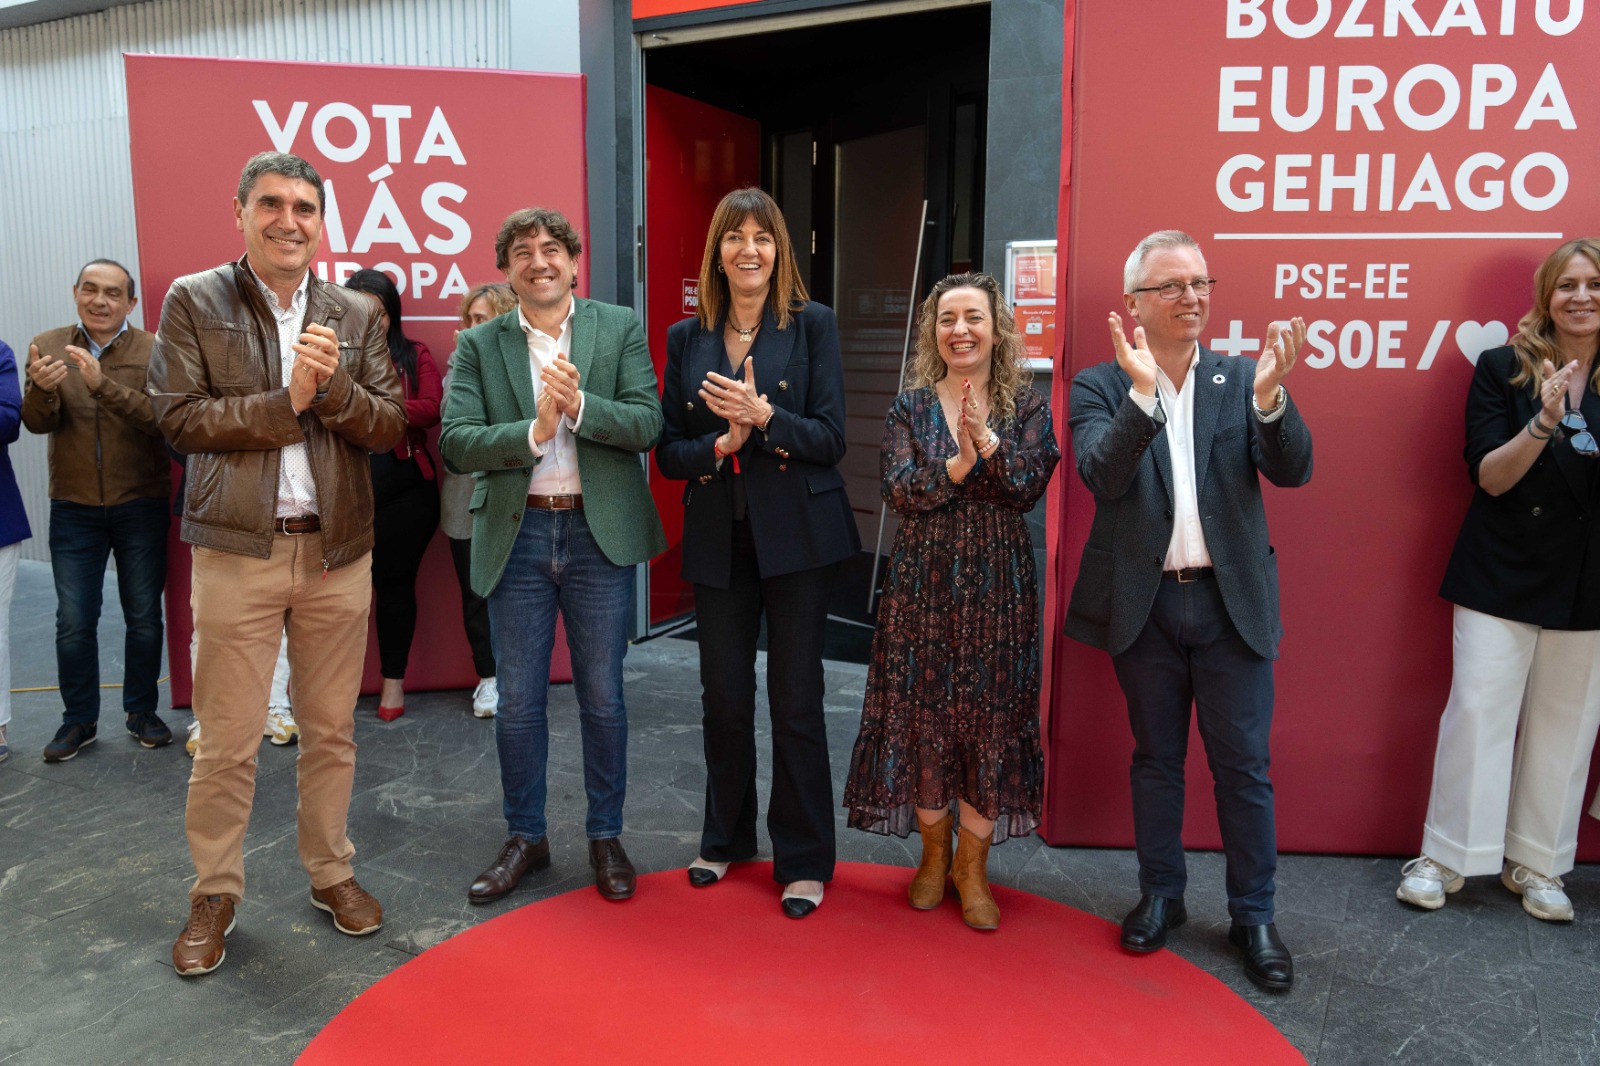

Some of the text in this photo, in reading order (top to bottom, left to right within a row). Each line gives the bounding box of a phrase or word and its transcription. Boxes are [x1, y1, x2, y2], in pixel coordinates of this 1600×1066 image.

[1218, 63, 1577, 132] EUROPA
[252, 100, 467, 165] VOTA
[1216, 152, 1569, 212] GEHIAGO
[1275, 263, 1409, 299] PSE-EE
